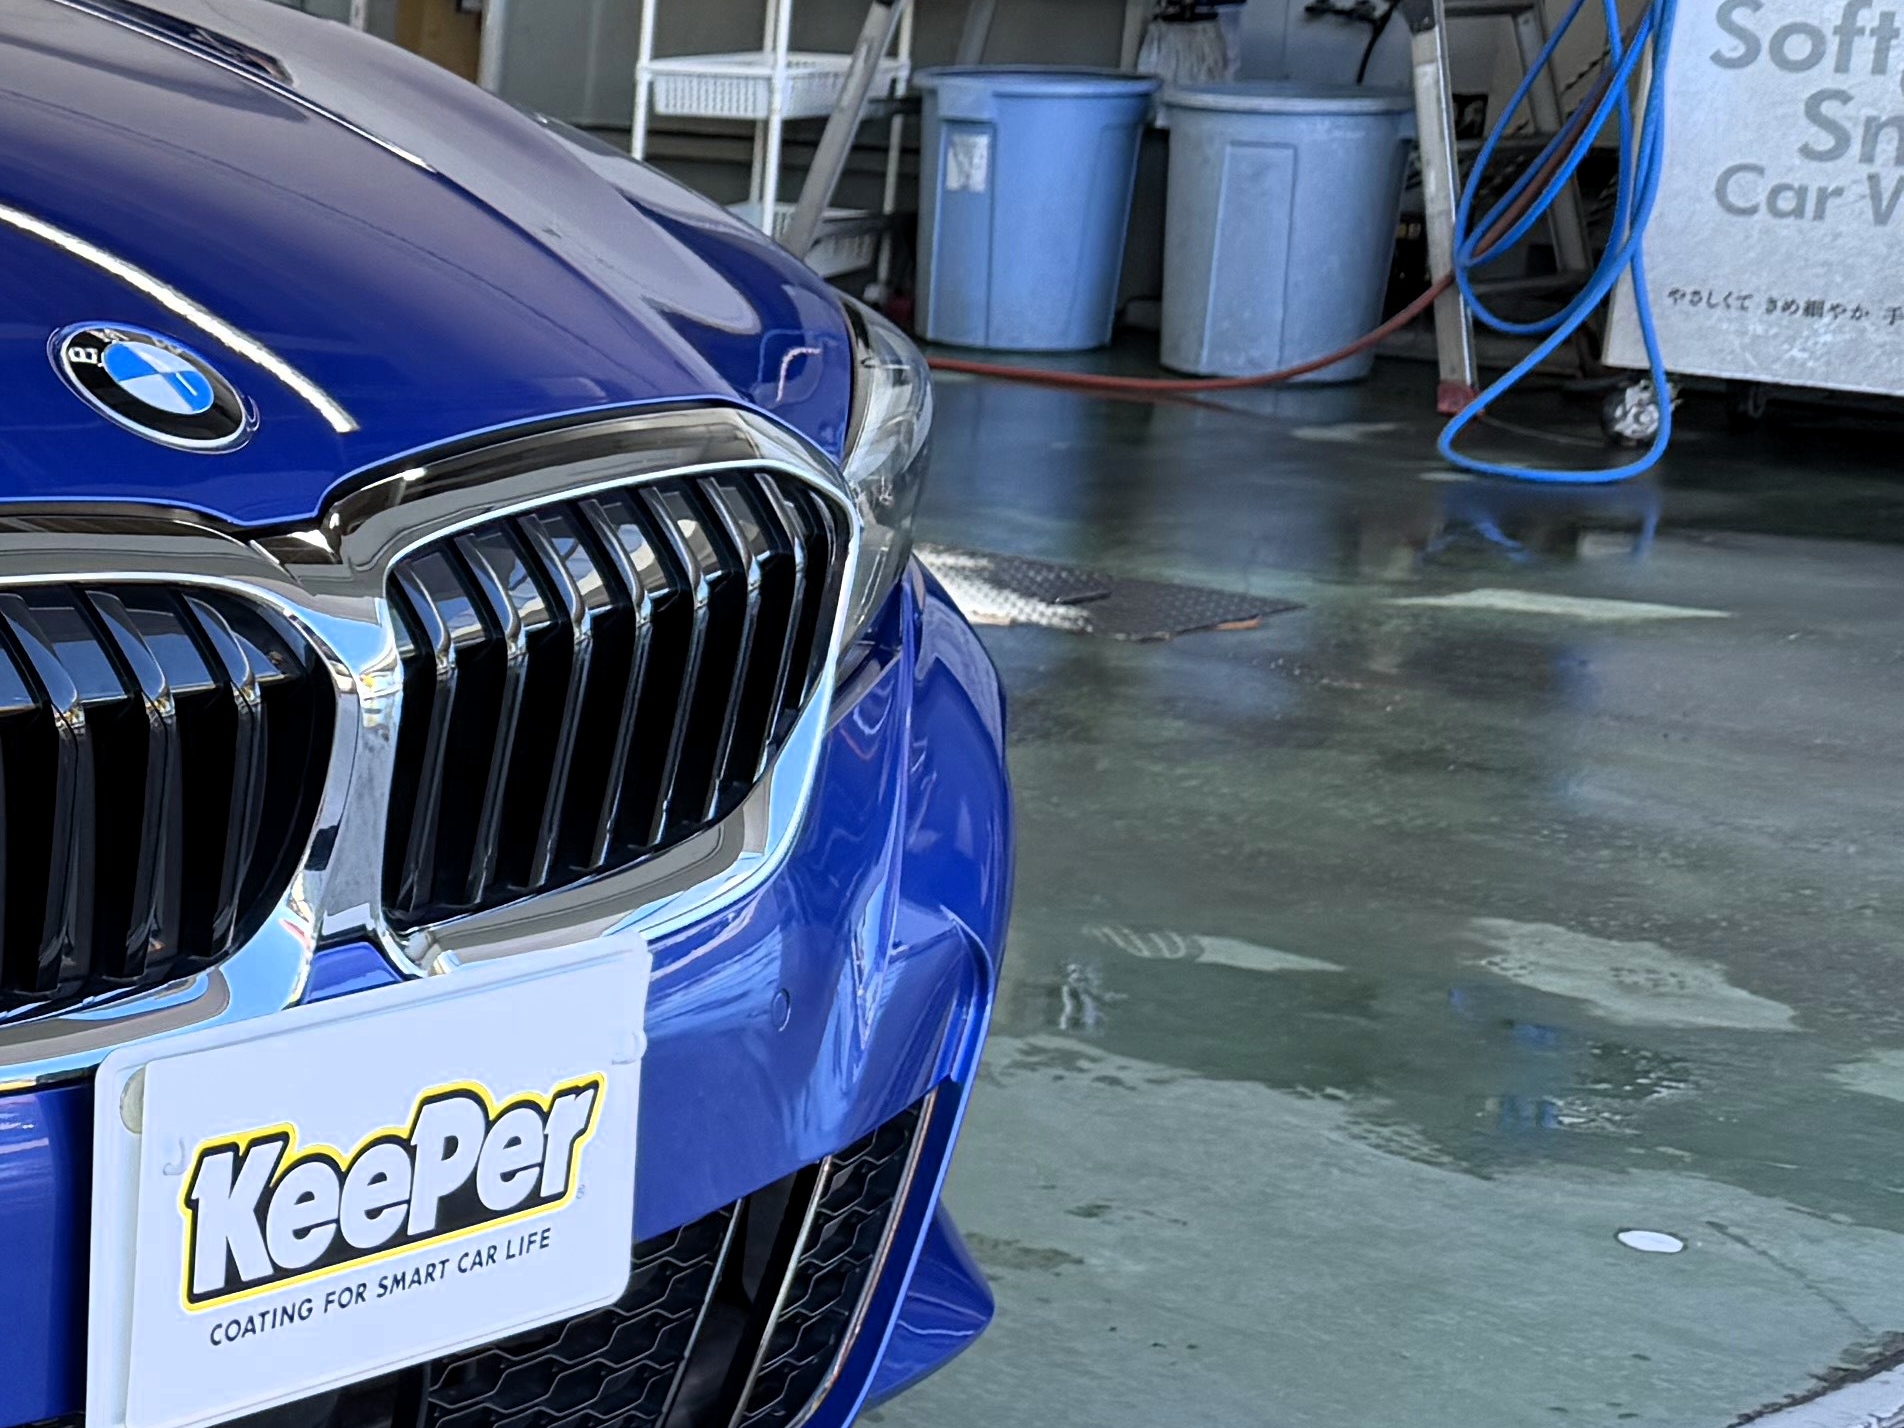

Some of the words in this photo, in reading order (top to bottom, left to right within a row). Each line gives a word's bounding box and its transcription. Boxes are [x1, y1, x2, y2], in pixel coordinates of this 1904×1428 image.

[1714, 162, 1845, 222] Car
[184, 1078, 600, 1300] KeePer
[209, 1296, 314, 1347] COATING
[323, 1281, 368, 1314] FOR
[376, 1257, 450, 1300] SMART
[457, 1243, 497, 1274] CAR
[504, 1227, 552, 1261] LIFE
